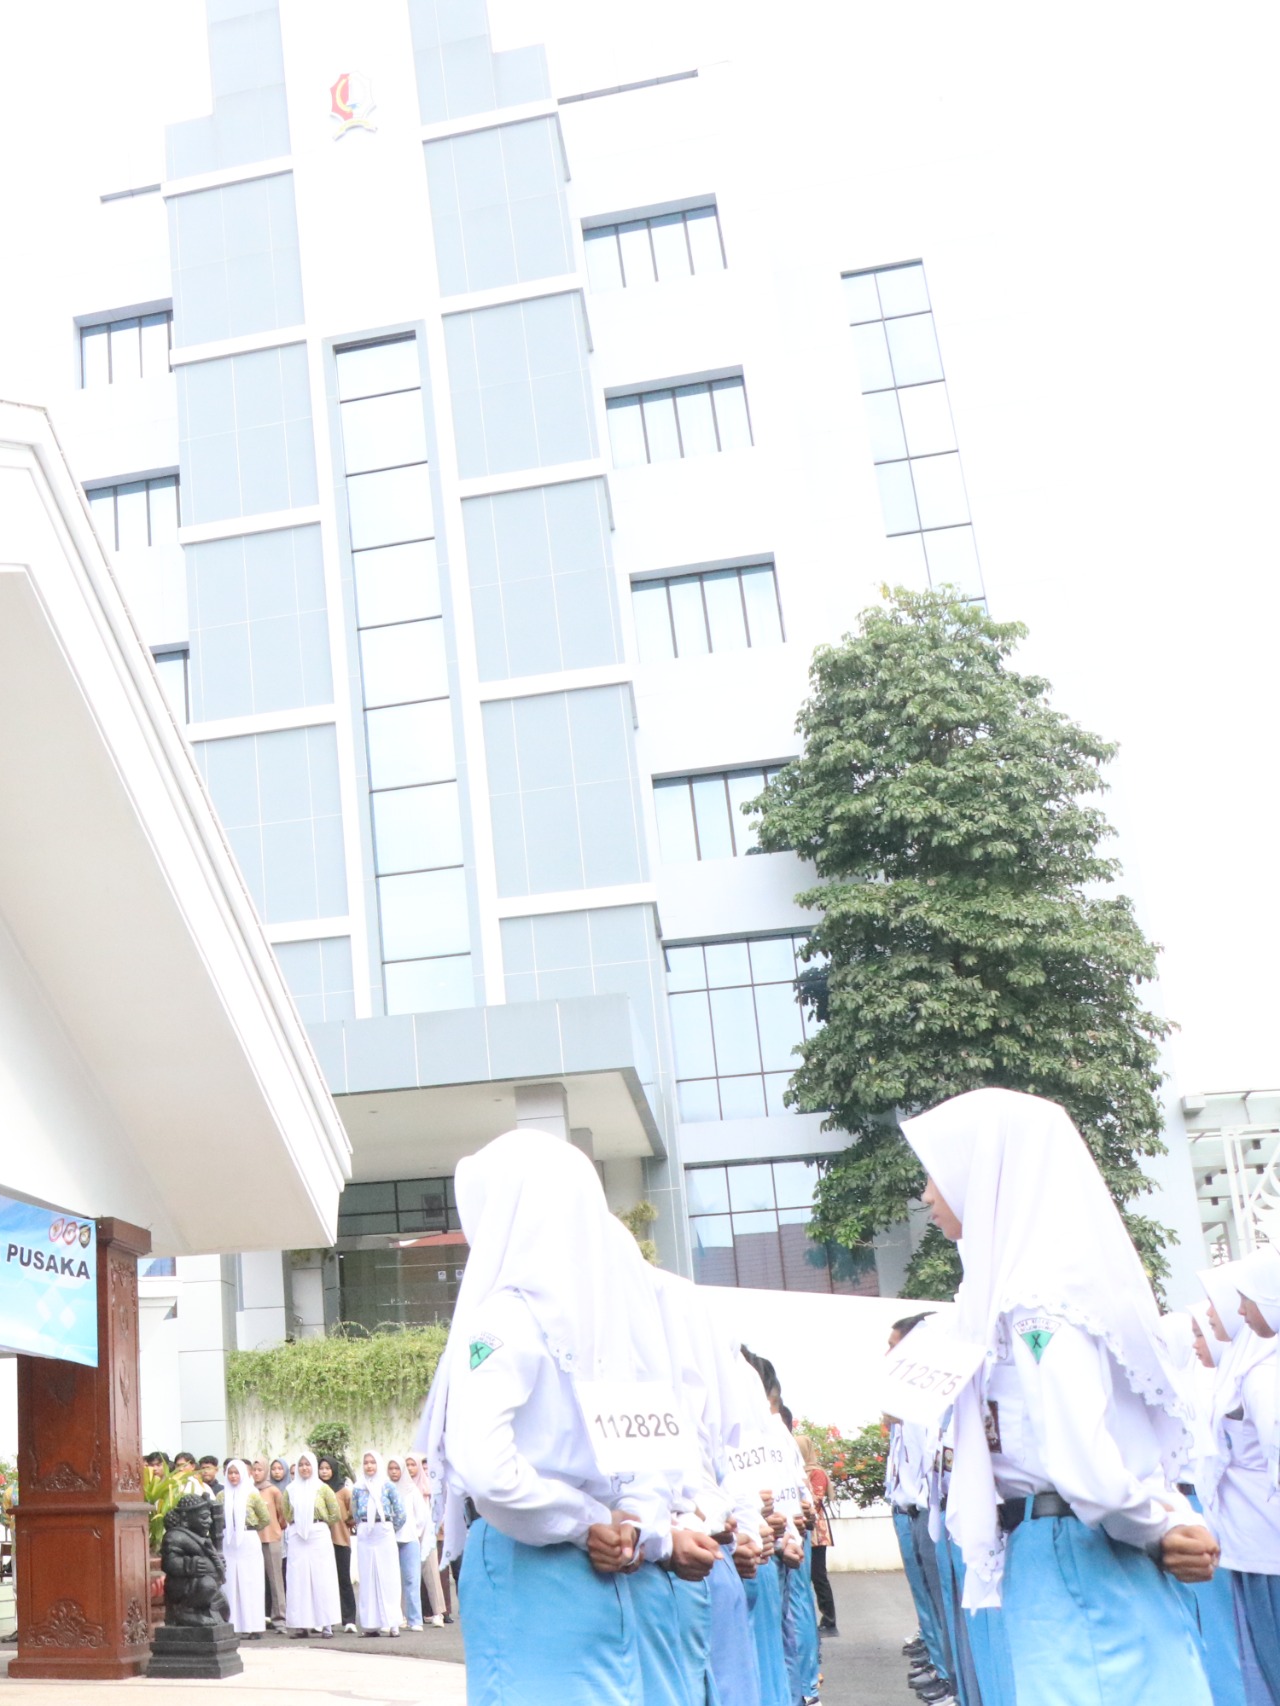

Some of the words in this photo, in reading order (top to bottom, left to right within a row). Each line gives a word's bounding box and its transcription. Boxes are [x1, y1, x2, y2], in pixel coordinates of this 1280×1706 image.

[6, 1243, 91, 1280] PUSAKA
[888, 1358, 963, 1397] 112575
[595, 1412, 680, 1438] 112826
